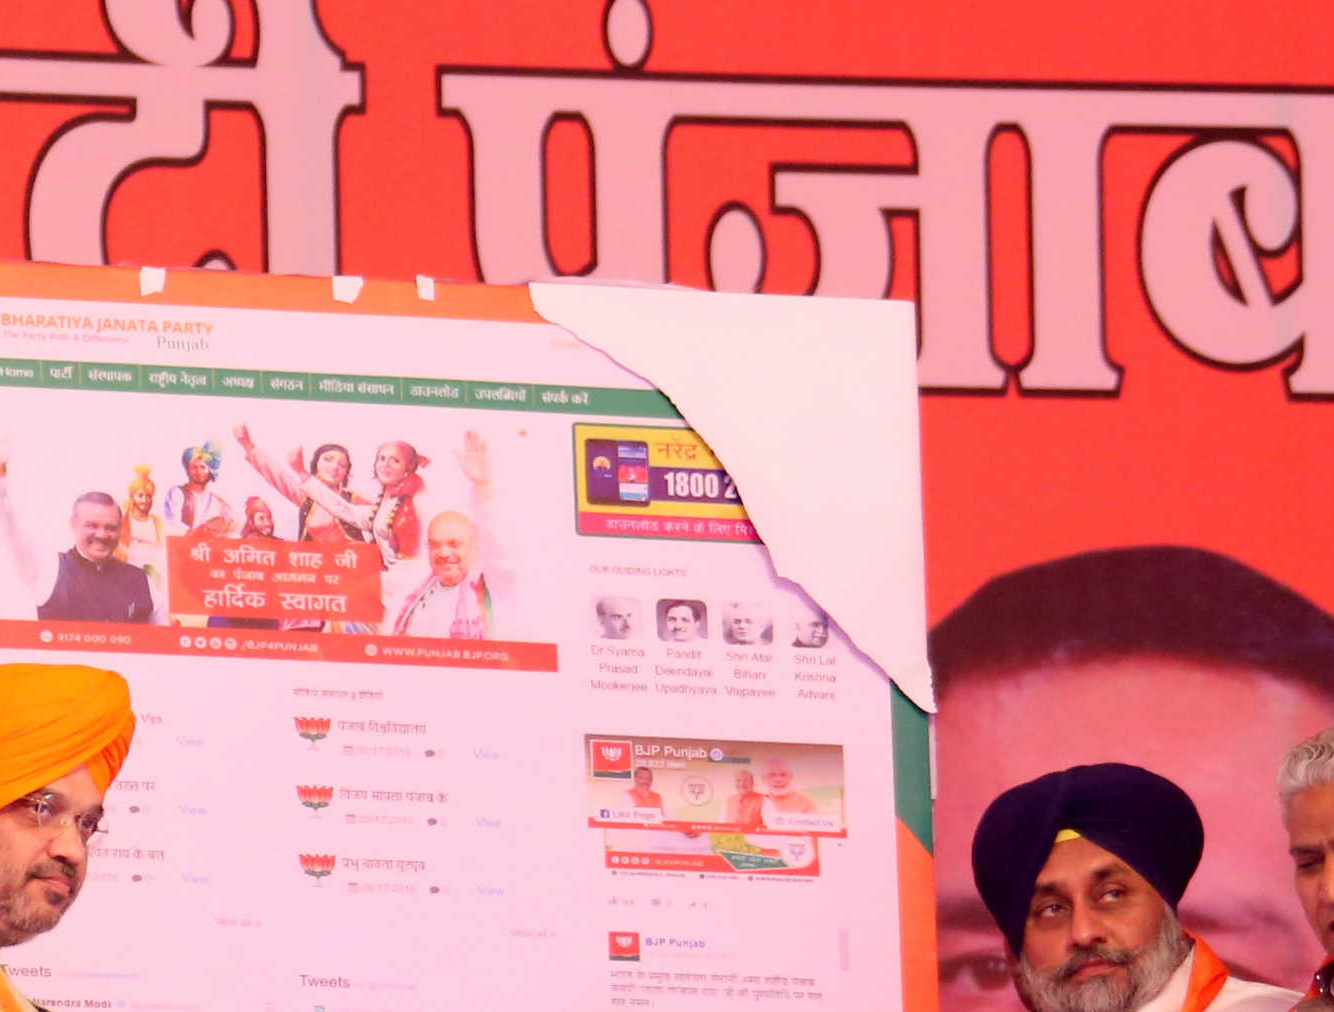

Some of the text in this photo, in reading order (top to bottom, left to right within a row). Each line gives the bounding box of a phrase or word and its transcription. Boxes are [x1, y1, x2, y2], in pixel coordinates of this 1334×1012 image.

[1, 313, 213, 335] BHARATIYA JANATA PARTY
[156, 335, 210, 352] Punjab
[0, 366, 34, 378] Home
[49, 365, 73, 380] पार्टी
[87, 368, 132, 383] संस्थापक
[270, 377, 304, 391] संगठन
[319, 378, 355, 394] मीडिया
[410, 383, 459, 399] डाउनलोड
[664, 471, 718, 498] 1800
[190, 543, 358, 568] श्री अमित शाह जी
[210, 567, 340, 585] का पंजाब आगमन पर
[588, 565, 687, 577] OUR GUIDING LIGHTS
[203, 584, 347, 612] हार्दिक स्वागत
[591, 645, 646, 660] Dr Syama
[666, 648, 702, 660] Pandit
[726, 651, 773, 663] Shri Atal
[795, 654, 836, 666] Shri Lal
[599, 662, 638, 674] Prasad
[655, 665, 713, 679] Deendayal
[733, 669, 766, 680] Bihari
[795, 671, 837, 684] Krishna
[590, 680, 649, 695] Mookerjee
[655, 683, 717, 698] Upadhyaya
[725, 685, 776, 700] Vajpayee
[797, 689, 836, 701] Advani
[635, 744, 708, 761] BJP Punjab
[645, 936, 706, 951] BJP Punjab
[0, 963, 52, 978] Tweets
[299, 974, 351, 990] Tweets
[84, 999, 112, 1009] Modi
